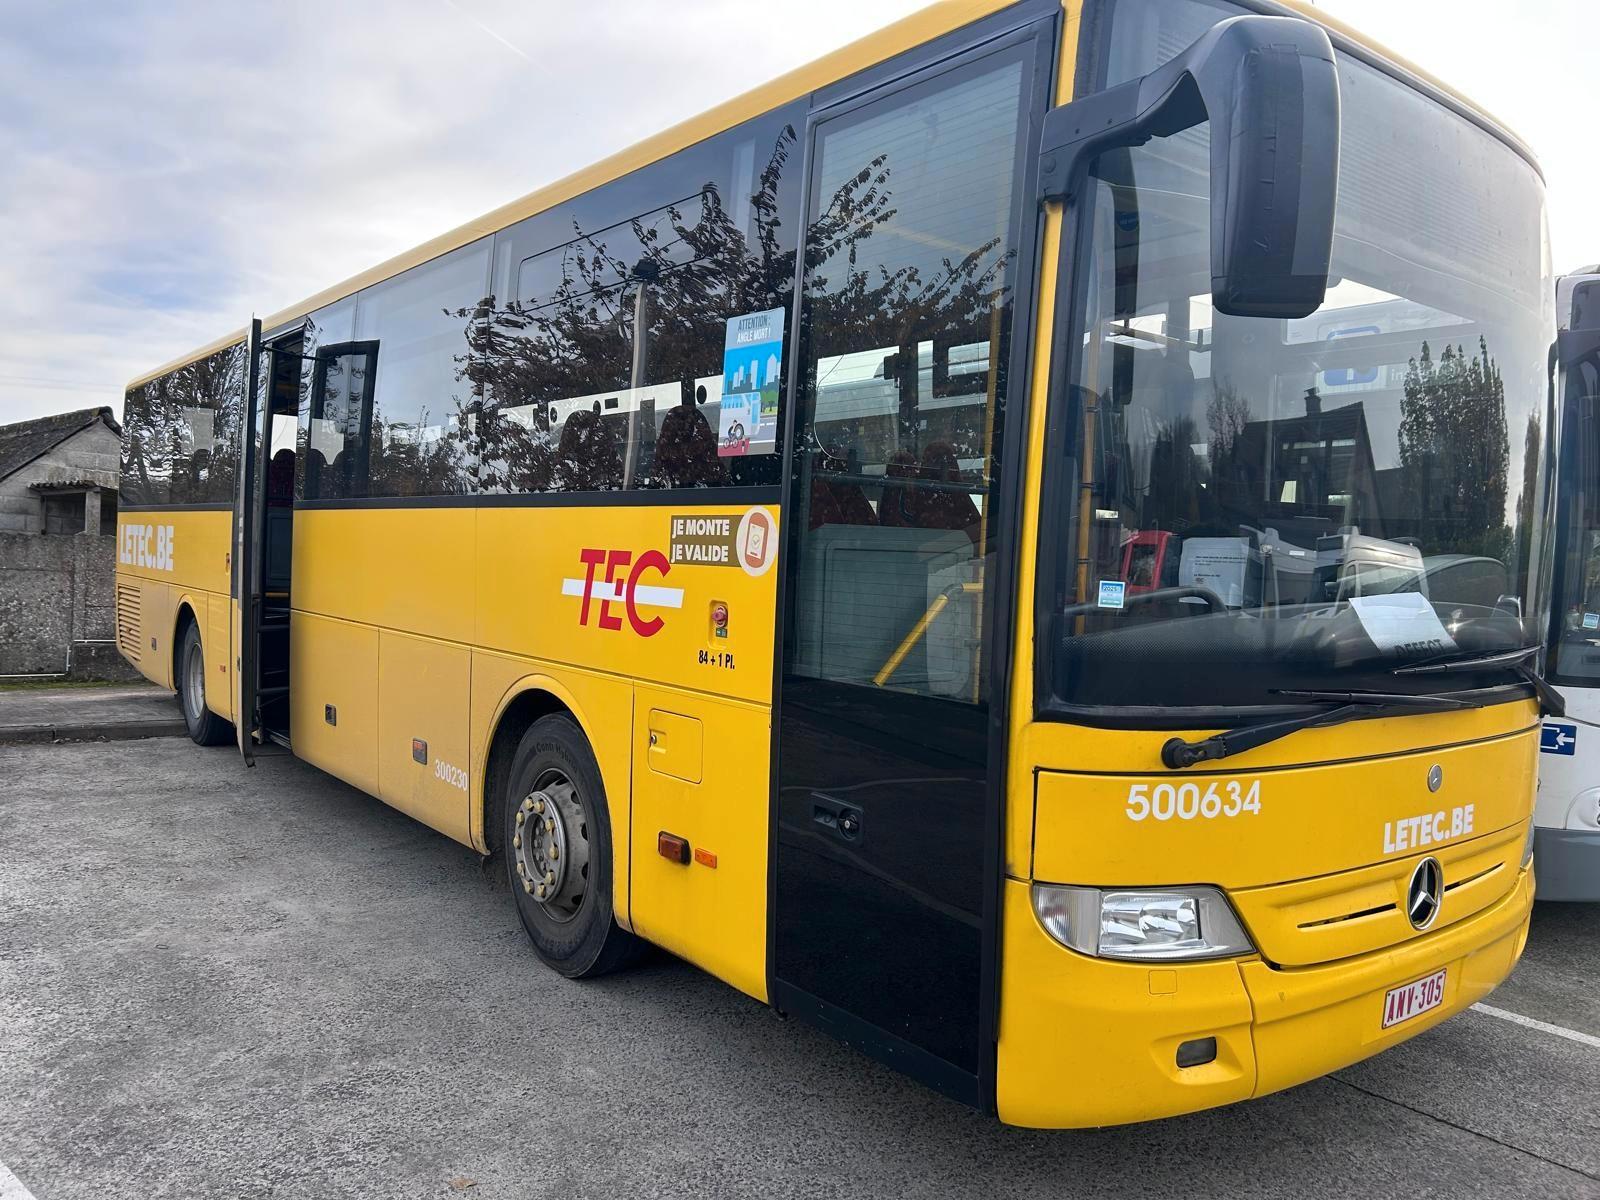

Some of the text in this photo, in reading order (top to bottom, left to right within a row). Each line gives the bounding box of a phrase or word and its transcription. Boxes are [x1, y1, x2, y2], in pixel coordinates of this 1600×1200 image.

[737, 330, 753, 345] ANGLE
[671, 519, 730, 539] JE MONTE
[119, 524, 175, 571] LETEC.BE
[670, 544, 729, 563] JE VALIDE
[579, 548, 671, 637] TEC
[698, 650, 709, 664] 84
[718, 653, 722, 667] 1
[435, 759, 467, 791] 300230
[1126, 780, 1261, 821] 500634
[1383, 804, 1474, 854] LETEC.BE
